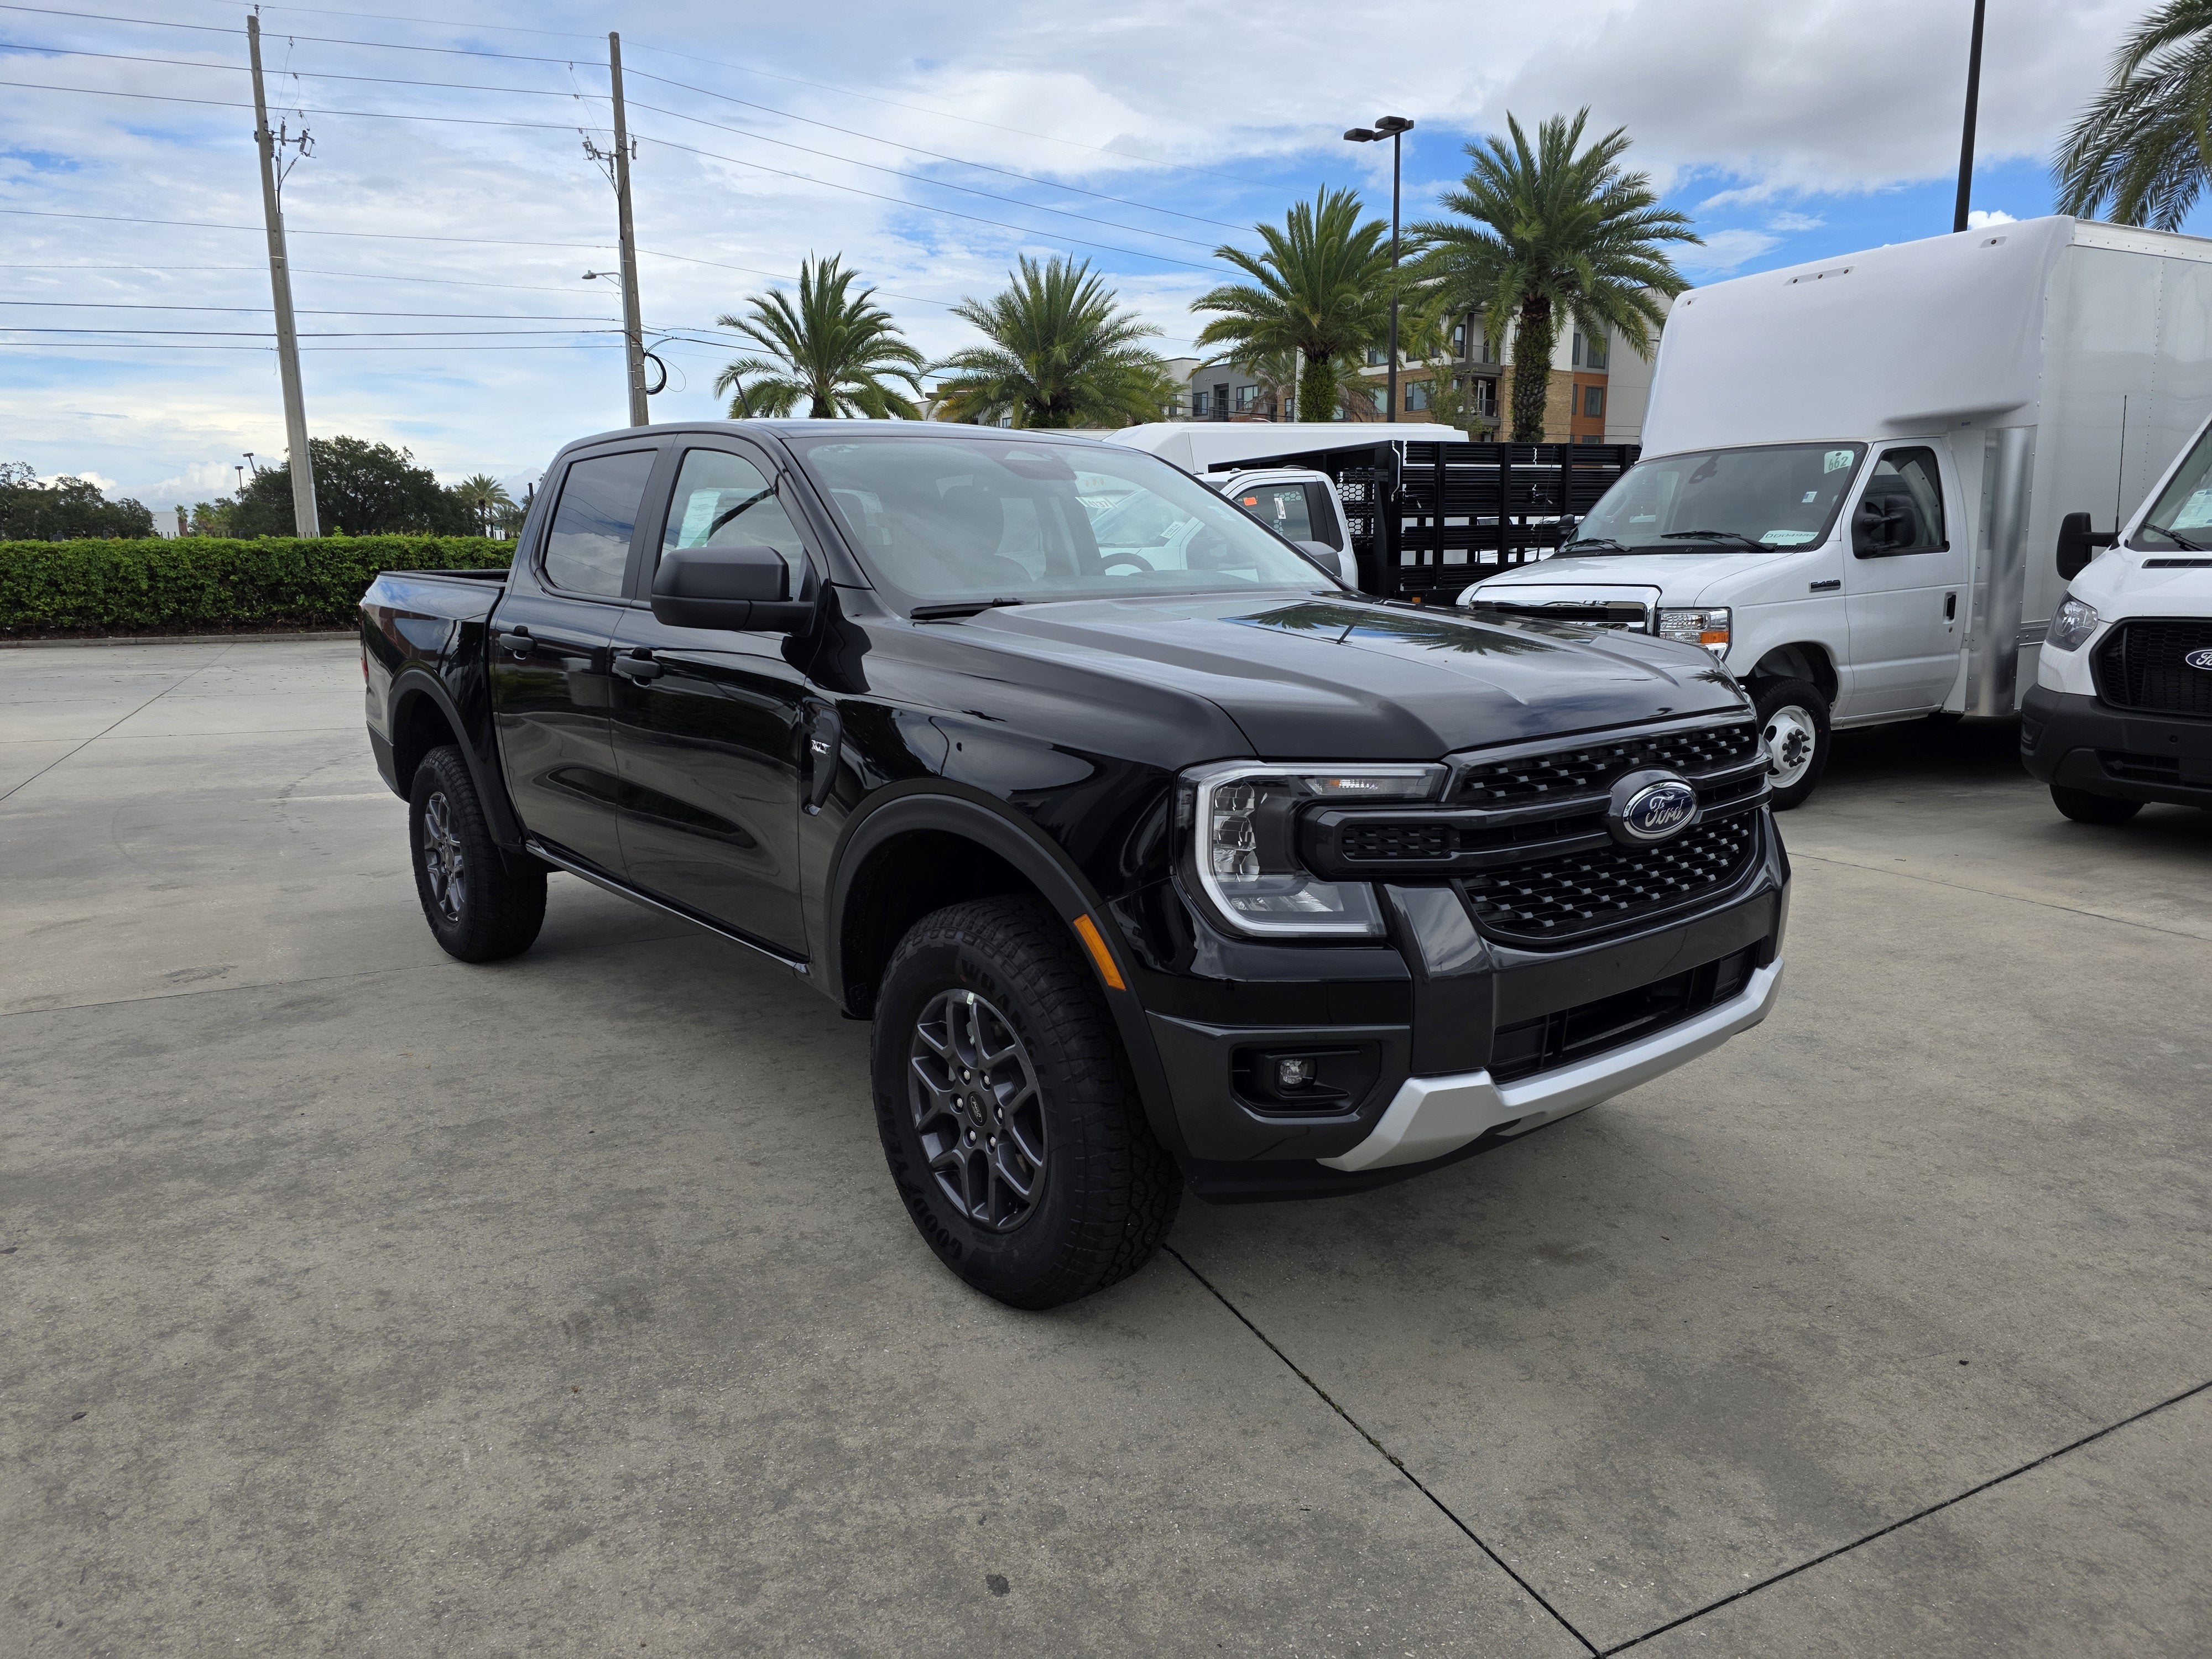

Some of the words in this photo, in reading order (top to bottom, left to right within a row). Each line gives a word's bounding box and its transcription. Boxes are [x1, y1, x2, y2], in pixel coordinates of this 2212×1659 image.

[1828, 456, 1849, 471] 662
[1811, 580, 1840, 589] E-450
[811, 739, 831, 754] XLT
[1645, 794, 1684, 827] Ford
